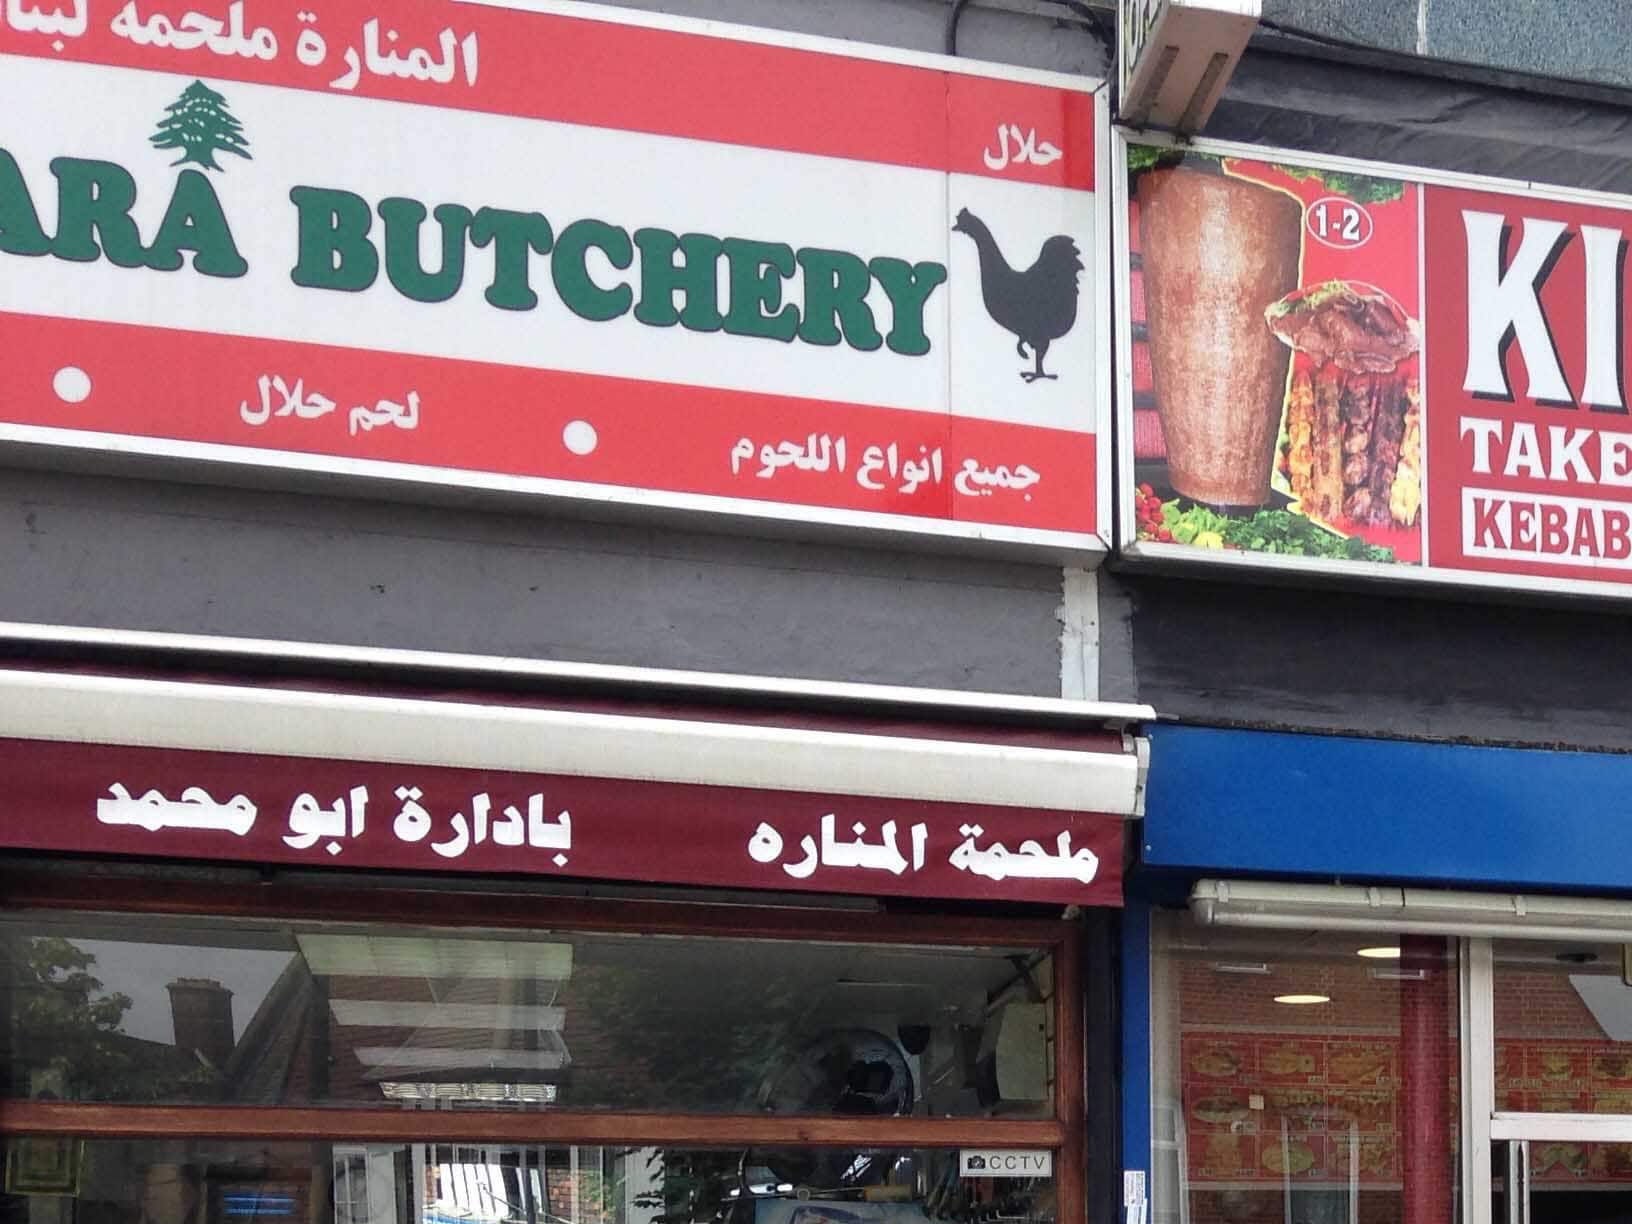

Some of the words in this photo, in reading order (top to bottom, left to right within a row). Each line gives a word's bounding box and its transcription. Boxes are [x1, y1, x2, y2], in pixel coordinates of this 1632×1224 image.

[297, 9, 479, 91] المنارة
[983, 124, 1063, 171] حلال
[289, 185, 948, 357] BUTCHERY
[240, 374, 336, 426] حلال
[349, 391, 420, 436] لحم
[731, 433, 847, 479] اللحوم
[857, 442, 942, 495] انواع
[953, 454, 1041, 502] جميع
[1472, 496, 1632, 560] KEBAB
[97, 782, 258, 836] محمد
[282, 785, 369, 856] ابو
[948, 822, 1100, 884] ملحمة
[988, 1154, 1047, 1171] CCTV
